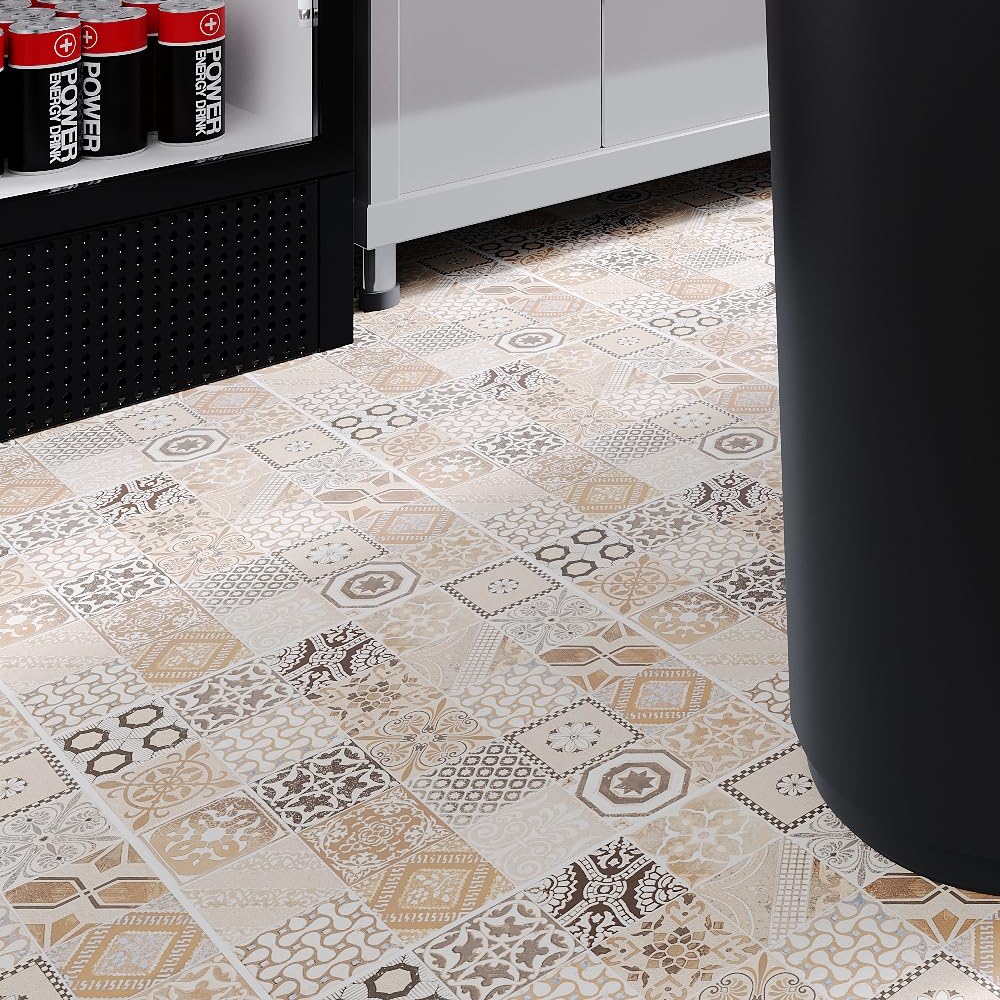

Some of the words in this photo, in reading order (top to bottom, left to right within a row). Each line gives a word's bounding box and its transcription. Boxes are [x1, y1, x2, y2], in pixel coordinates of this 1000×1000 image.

[49, 72, 62, 122] ENERGY
[195, 49, 207, 97] ENERGY
[204, 46, 222, 135] POWER
[60, 67, 78, 163] POWER
[82, 62, 101, 152] POWER
[195, 100, 207, 136] DRINK
[49, 124, 62, 164] DRINK
